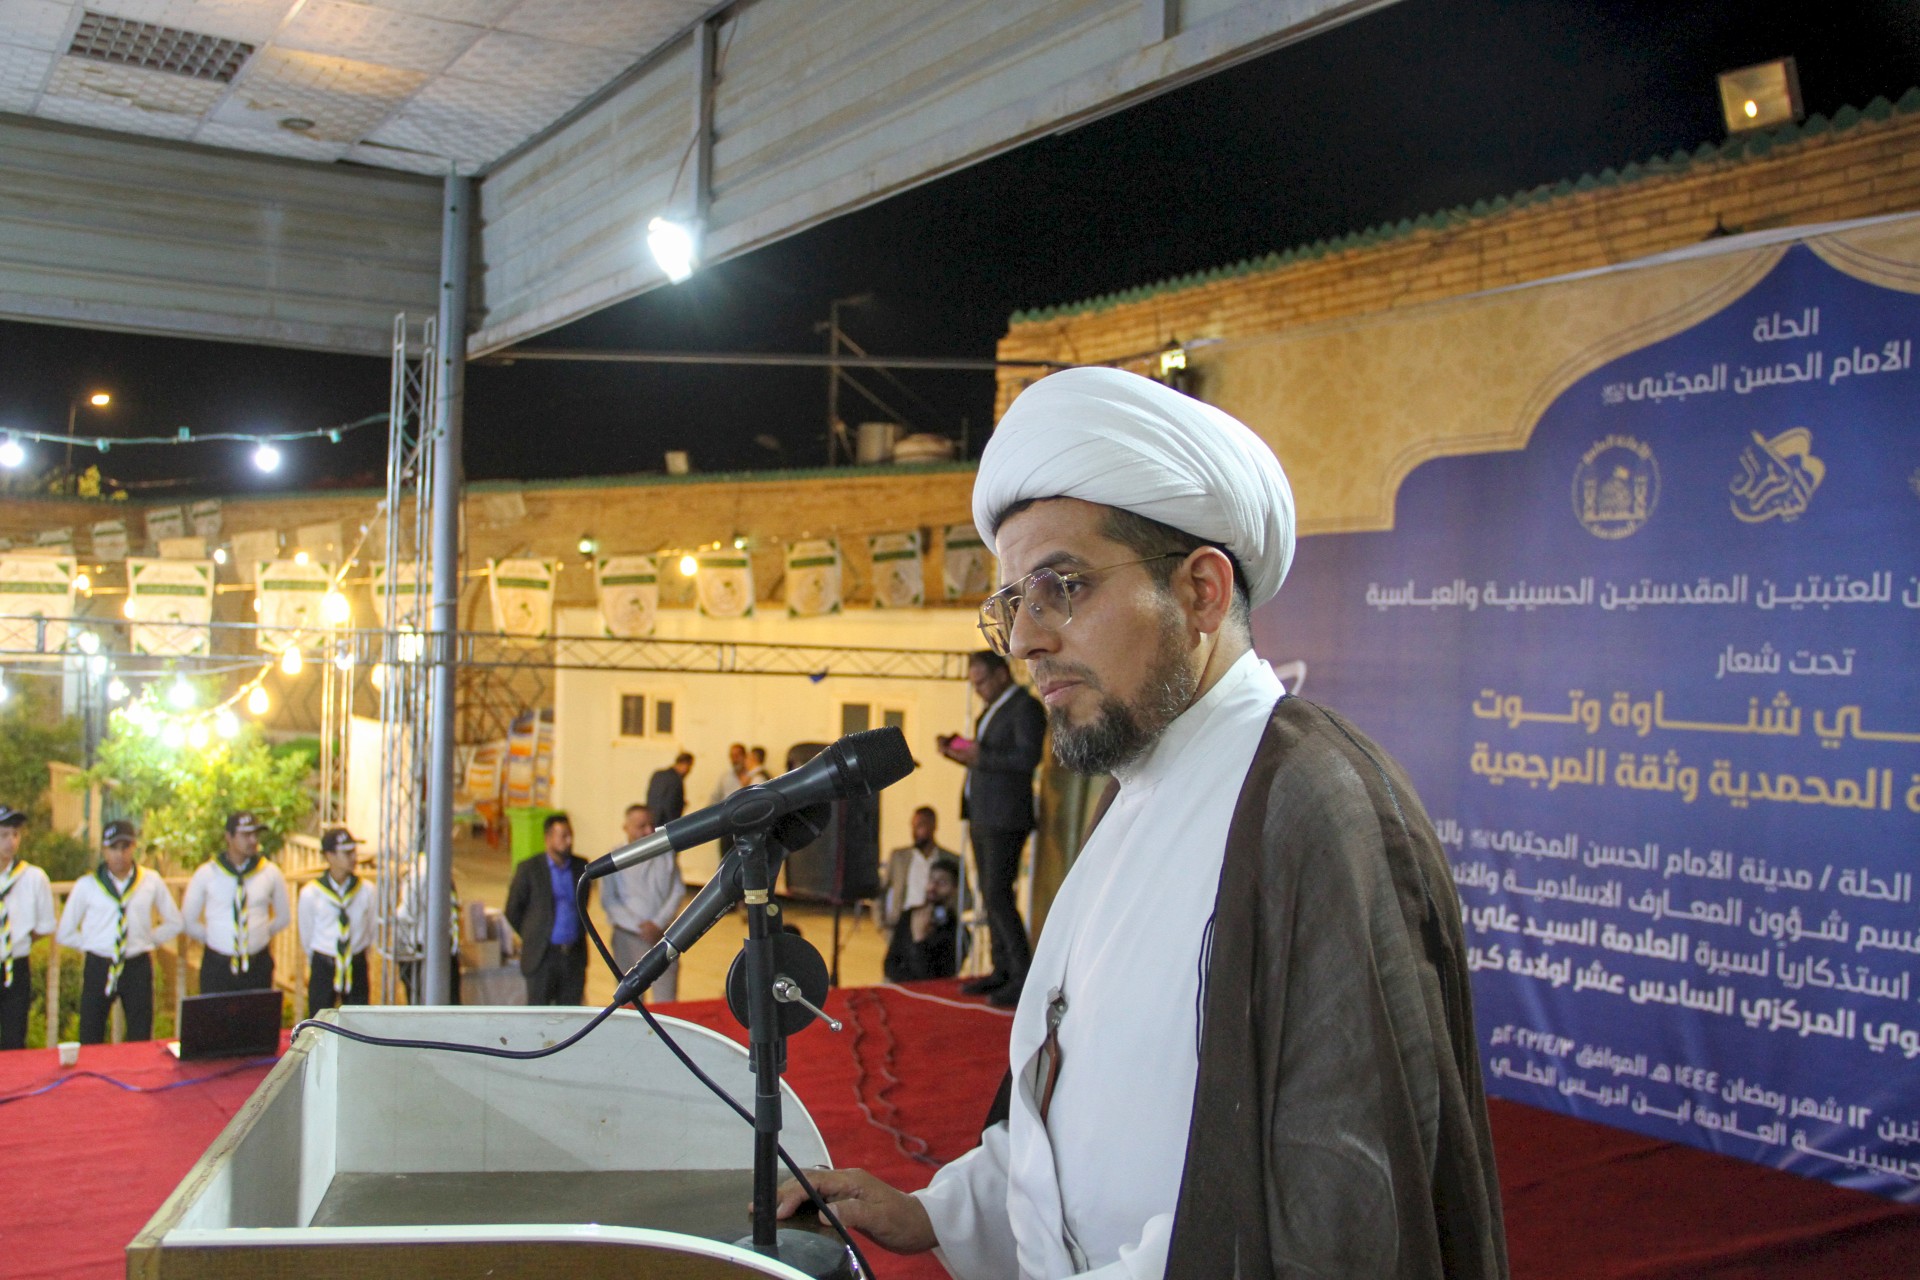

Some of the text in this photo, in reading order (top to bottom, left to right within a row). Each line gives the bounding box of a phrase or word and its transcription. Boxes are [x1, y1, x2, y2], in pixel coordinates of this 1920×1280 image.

[1752, 307, 1819, 342] الحلة
[1733, 351, 1823, 393] الحسن
[1365, 578, 1478, 611] والعباسية
[1483, 577, 1594, 611] الحسينية
[1600, 574, 1748, 611] المقدستين
[1756, 571, 1892, 610] للعتبتين
[1715, 642, 1856, 679] تحت شعار
[1470, 742, 1607, 791] المرجعية
[1614, 749, 1699, 803] وثقة
[1708, 759, 1893, 811] المحمدية
[1583, 840, 1659, 870] الحسن
[1739, 857, 1813, 893] مدينة
[1838, 867, 1912, 903] الحلة
[1472, 904, 1521, 935] علي
[1628, 888, 1742, 927] المعارف
[1748, 906, 1849, 943] شؤون
[1522, 916, 1598, 947] السيد
[1600, 923, 1689, 962] العلامة
[1507, 949, 1571, 988] لولادة
[1573, 959, 1625, 995] عشر
[1695, 941, 1770, 977] لسيرة
[1629, 978, 1735, 1015] السادس
[1740, 998, 1856, 1040] المركزي
[1490, 1056, 1556, 1087] الحلي
[1575, 1044, 1648, 1078] الموافق
[1675, 1064, 1720, 1094] ١٤٤٤
[1721, 1077, 1787, 1116] رمضان
[1788, 1096, 1844, 1124] شهر
[1694, 1104, 1787, 1147] العلامة
